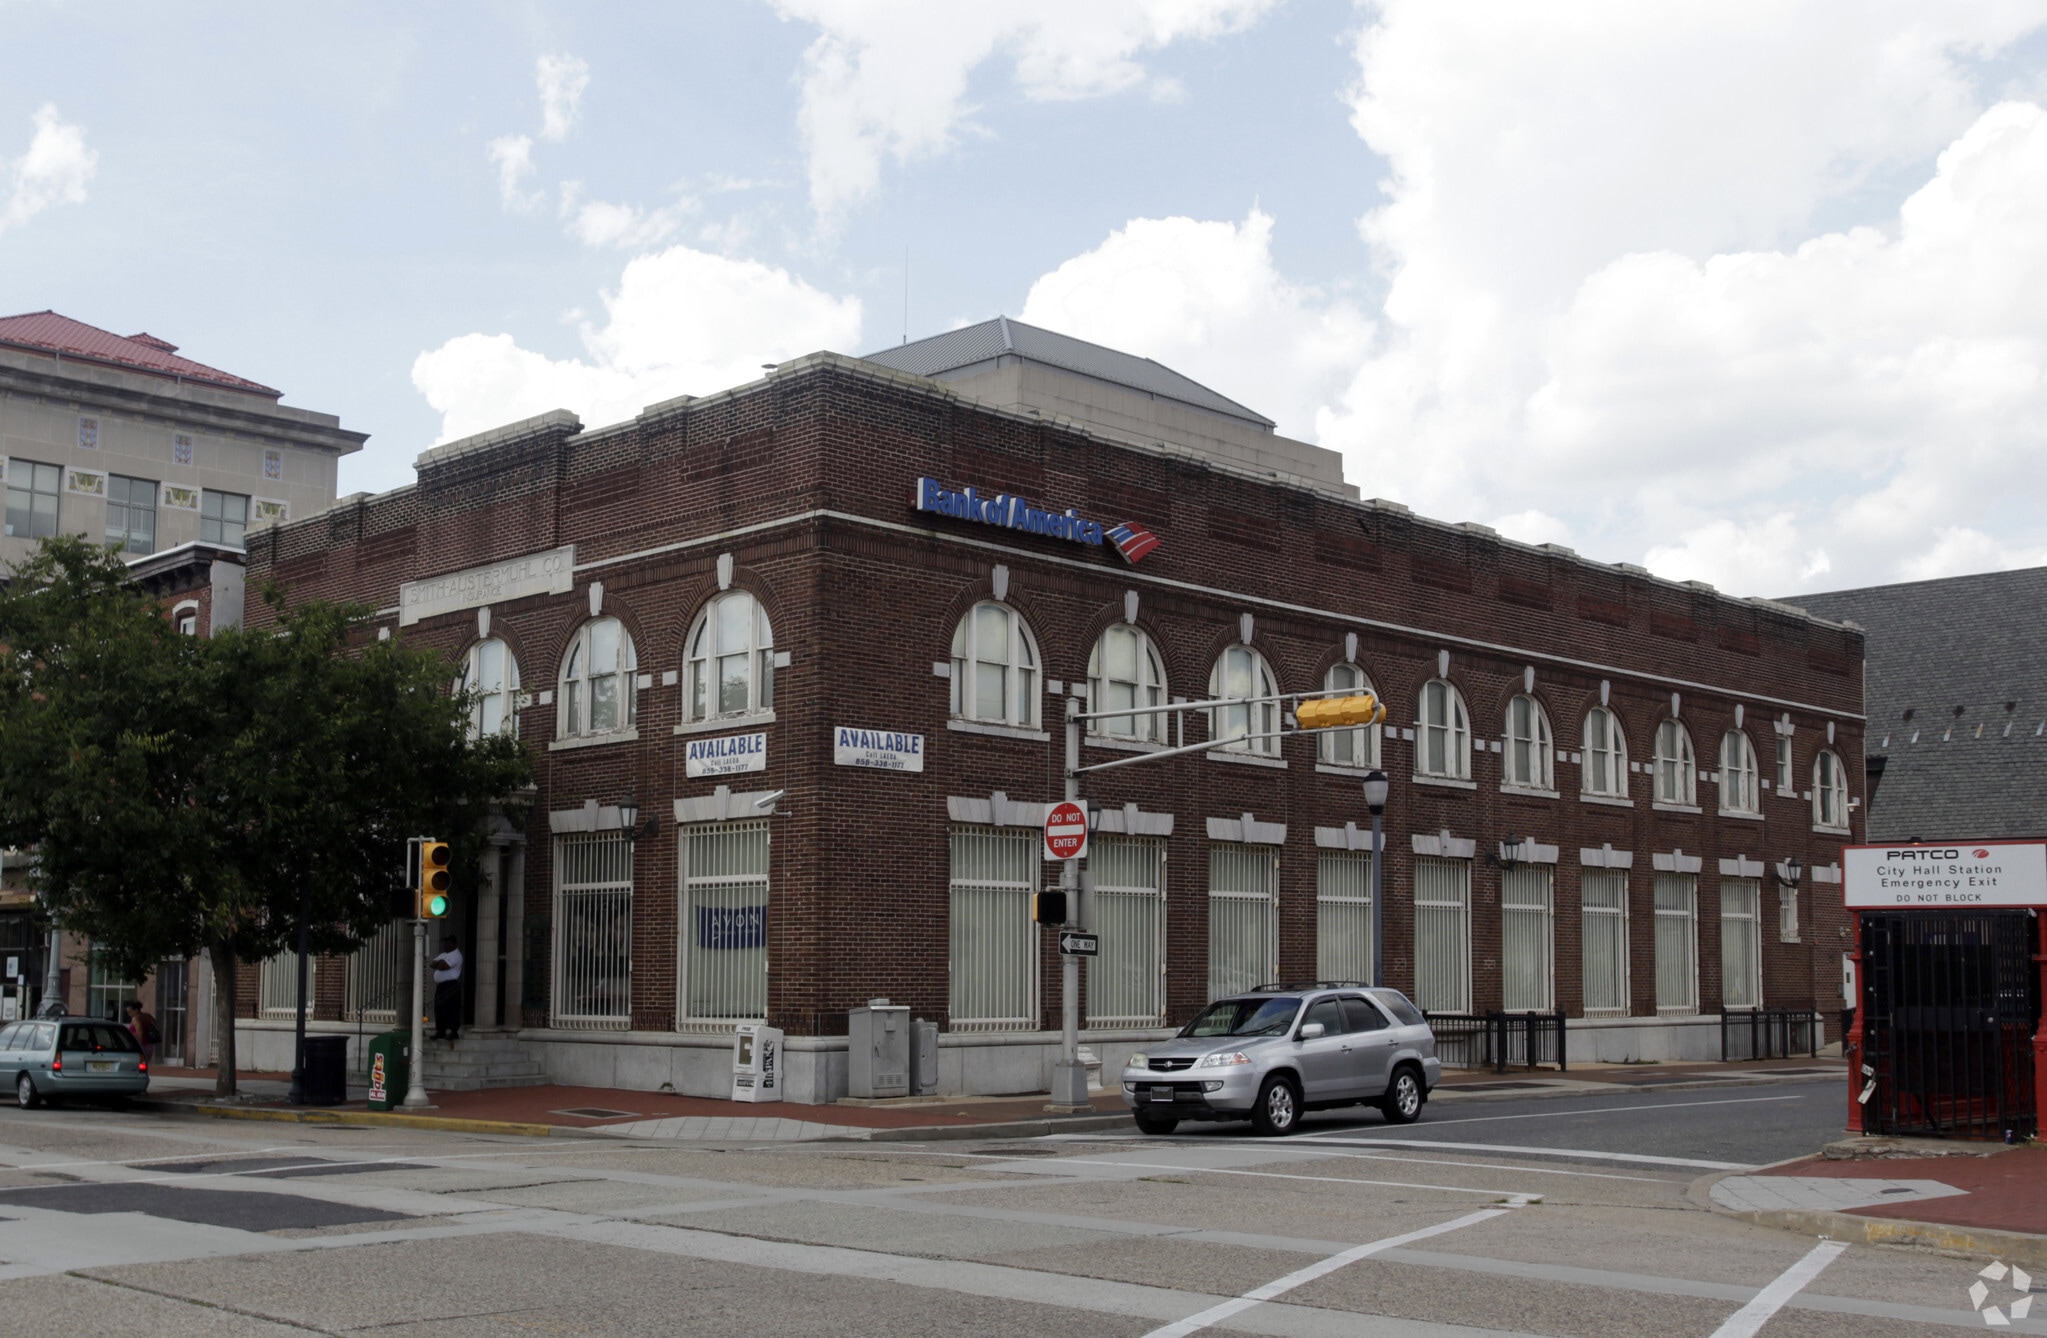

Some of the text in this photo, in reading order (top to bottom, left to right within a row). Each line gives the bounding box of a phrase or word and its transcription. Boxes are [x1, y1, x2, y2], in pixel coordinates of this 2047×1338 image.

[917, 477, 1103, 545] Bank of America
[410, 555, 565, 603] SMITH-AUSTERMUHL CO.
[462, 587, 502, 603] INSURANCE
[689, 735, 762, 760] AVAILABLE
[839, 729, 919, 754] AVAILABLE
[1052, 812, 1080, 823] DO NOT
[1053, 838, 1077, 848] ENTER
[1887, 849, 1959, 861] PATCO
[1877, 864, 2002, 877] City Hall Station
[1881, 876, 1997, 889] Emergency Exit
[1896, 893, 1982, 902] DO NOT BLOCK
[711, 913, 760, 928] AVON
[1070, 939, 1094, 949] ONE WAY
